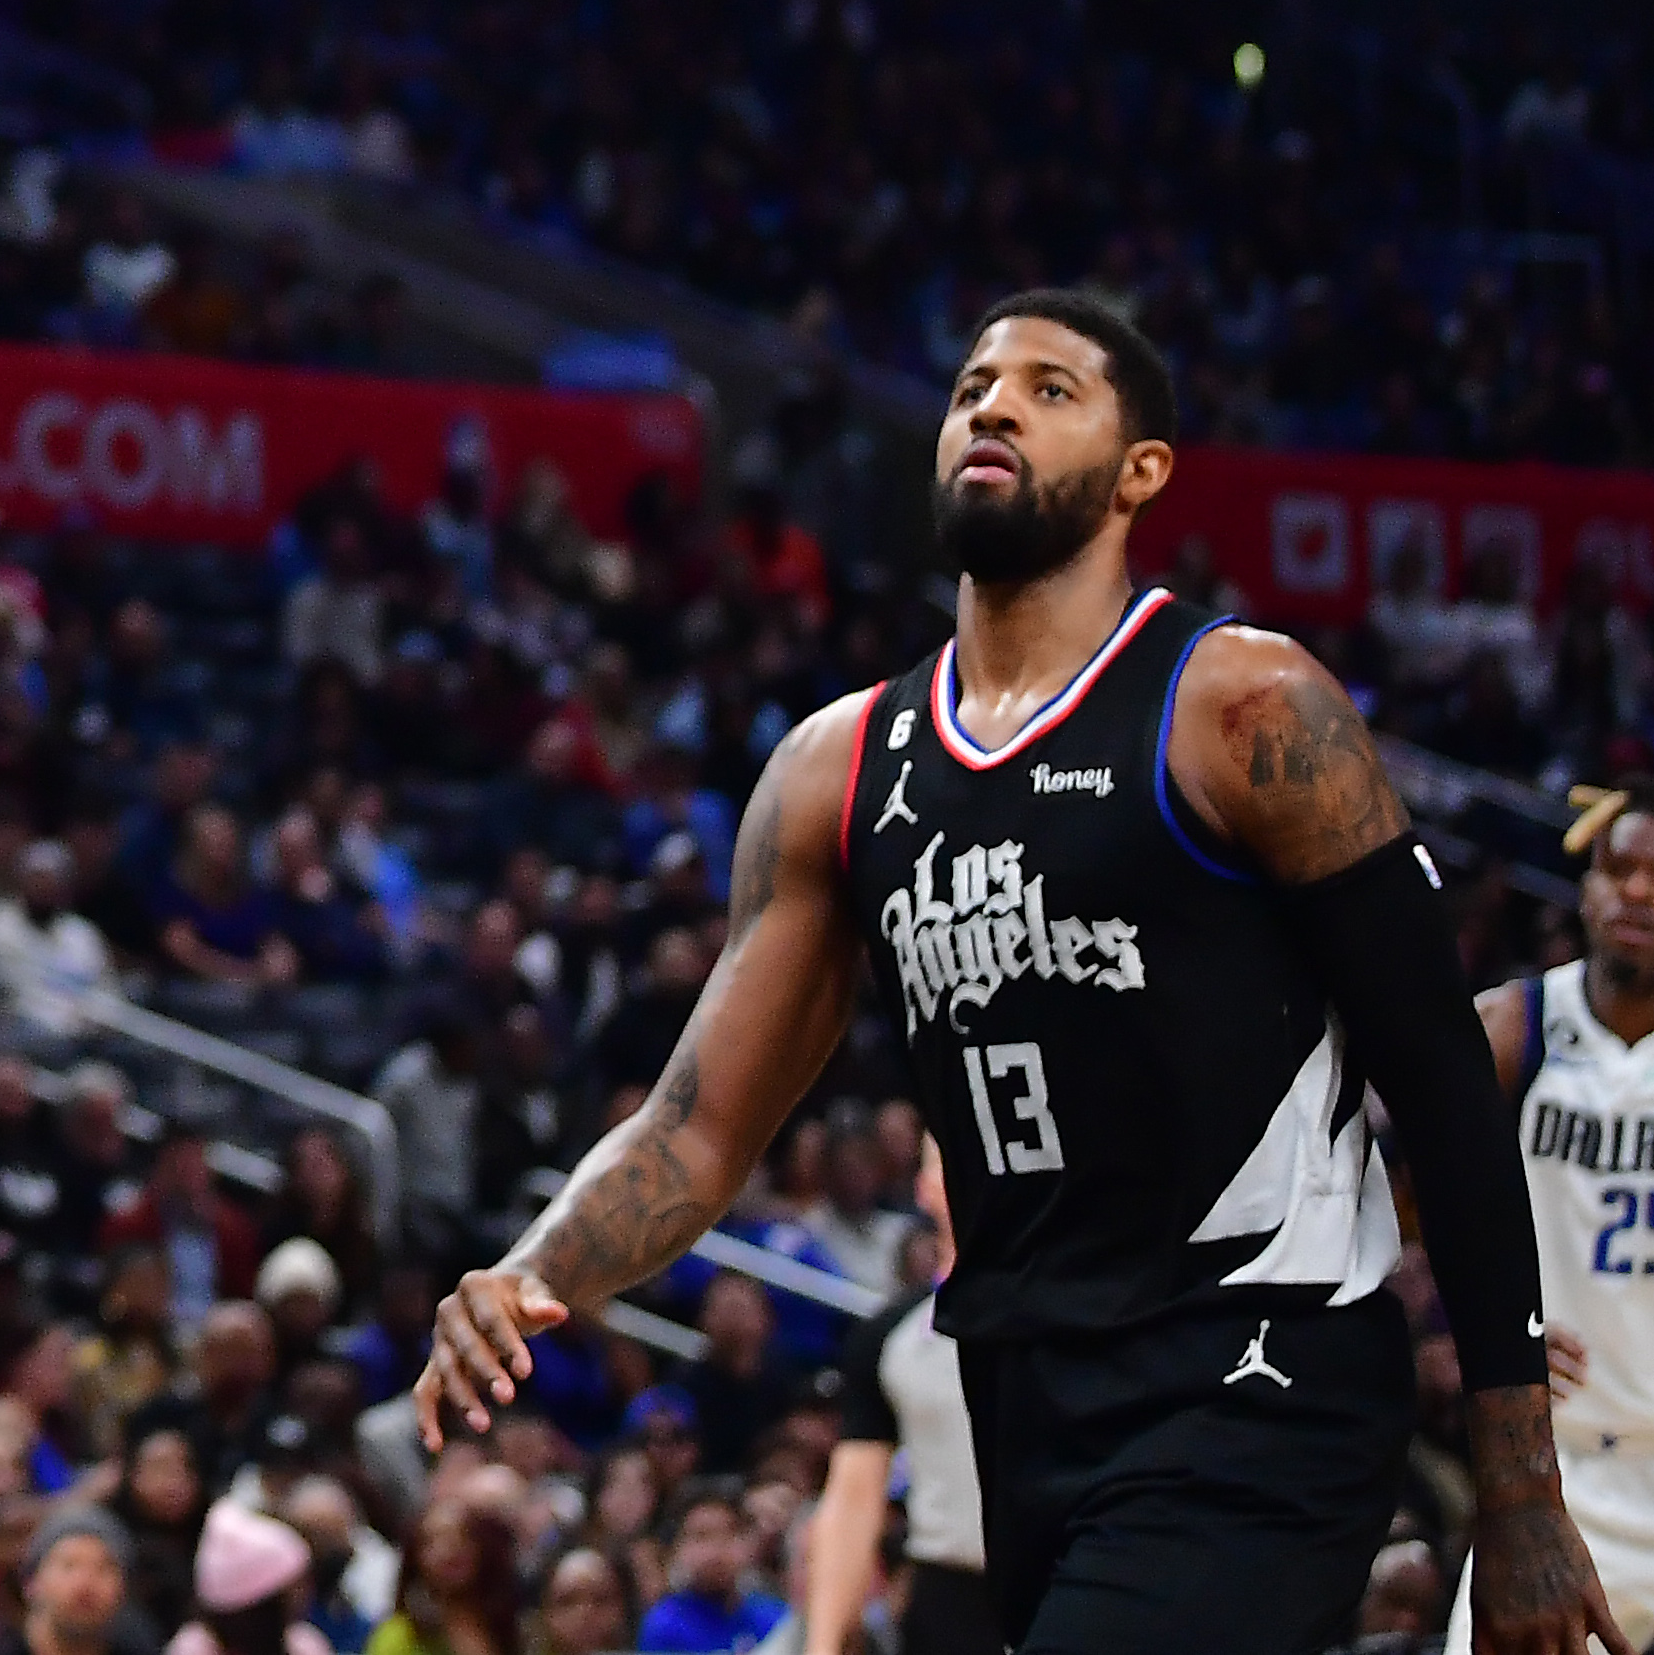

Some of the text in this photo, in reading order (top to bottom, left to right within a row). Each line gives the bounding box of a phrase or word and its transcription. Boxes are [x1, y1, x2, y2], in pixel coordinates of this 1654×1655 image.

[887, 708, 918, 750] 6
[1030, 762, 1116, 799] honey
[912, 830, 1025, 924] Los
[880, 873, 1146, 1044] Angeles
[962, 1041, 1065, 1176] 13
[1592, 1188, 1654, 1275] 2
